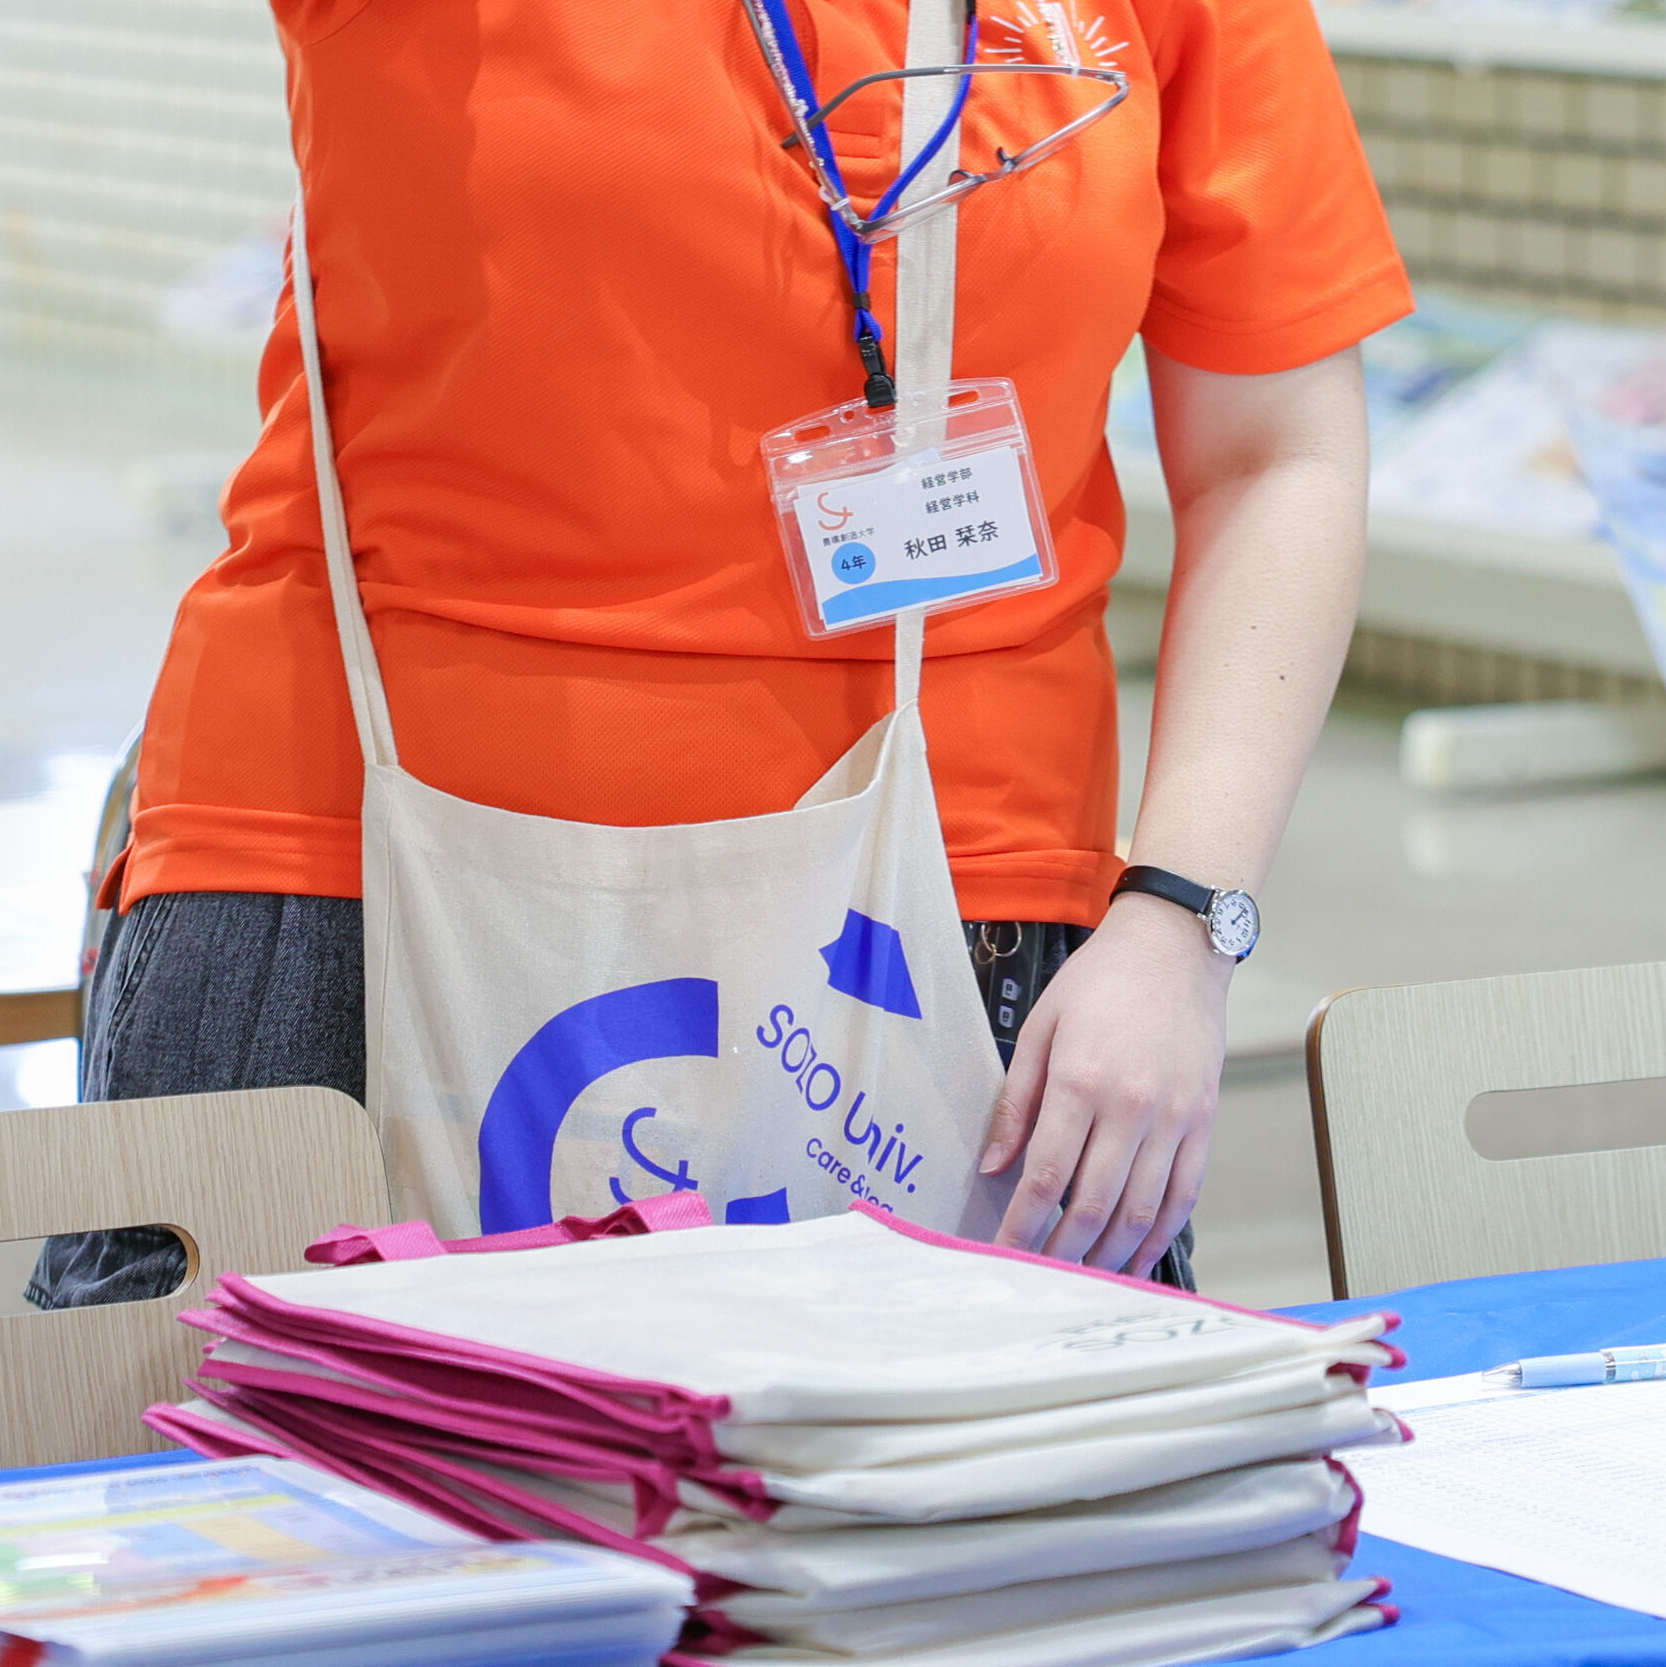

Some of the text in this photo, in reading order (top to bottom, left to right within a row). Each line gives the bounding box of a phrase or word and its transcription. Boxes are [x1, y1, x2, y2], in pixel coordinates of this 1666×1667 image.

[921, 467, 973, 490] 経営学部
[925, 490, 980, 514] 経営学科
[904, 520, 999, 561] 秋田 栞奈
[841, 555, 867, 572] 4年
